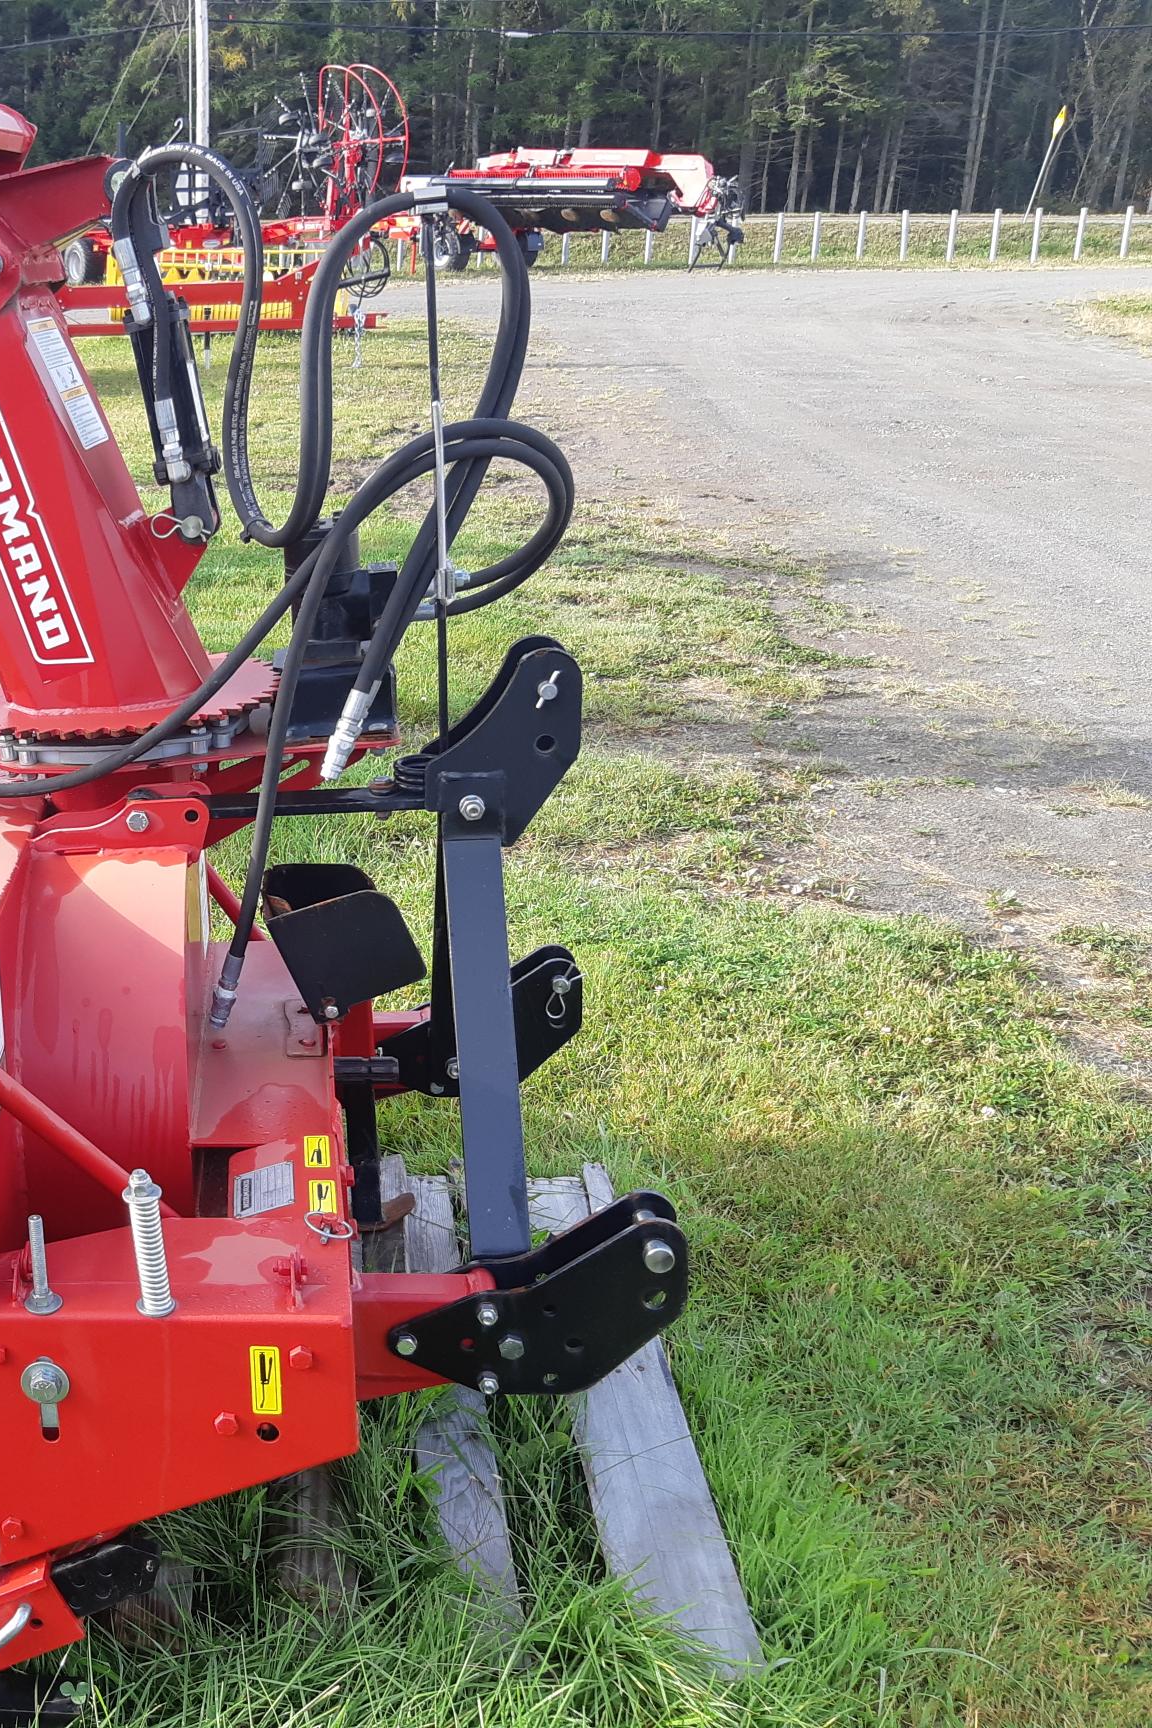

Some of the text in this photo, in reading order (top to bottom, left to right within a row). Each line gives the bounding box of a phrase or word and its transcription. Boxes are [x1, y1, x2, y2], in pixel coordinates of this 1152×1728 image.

[204, 153, 227, 171] MADE
[225, 169, 235, 180] IN
[231, 179, 244, 196] USA
[234, 362, 246, 399] Worldwide
